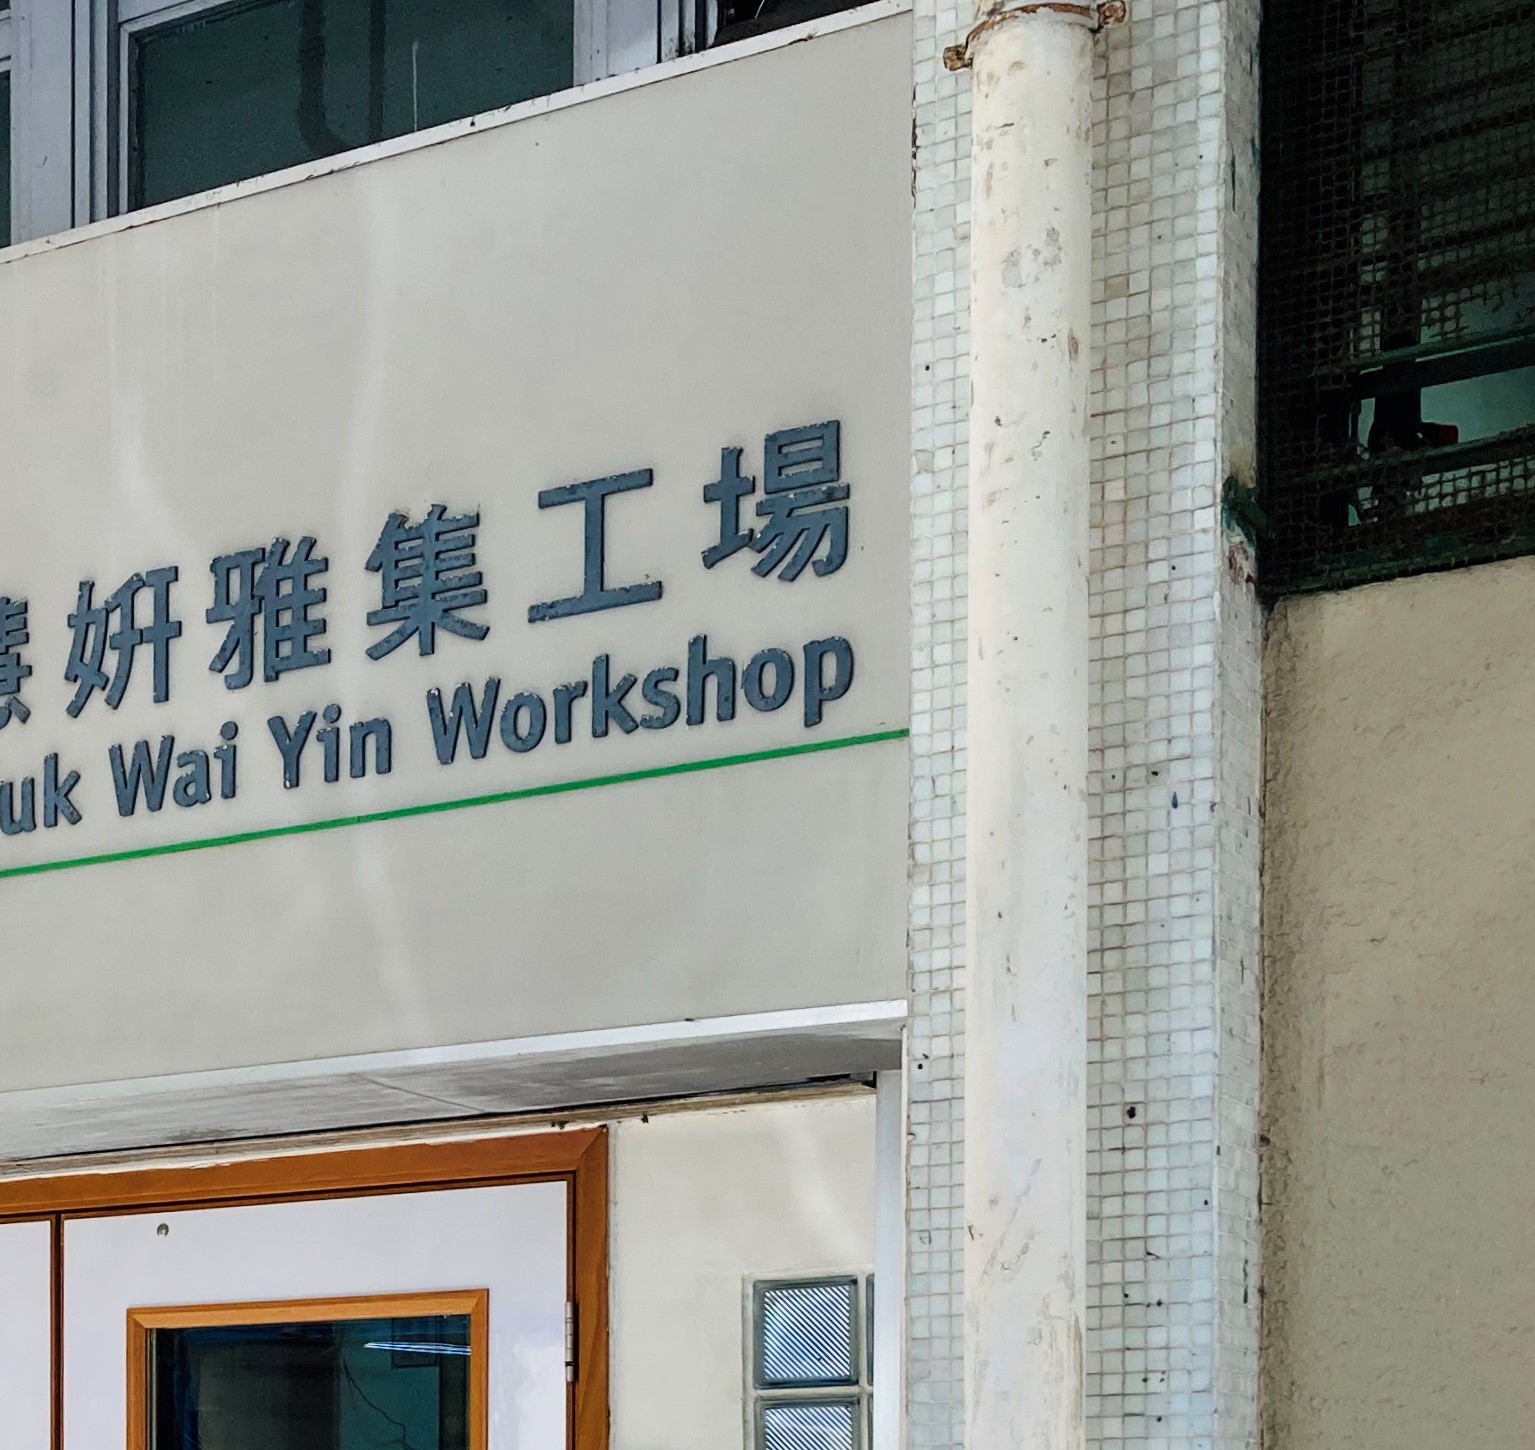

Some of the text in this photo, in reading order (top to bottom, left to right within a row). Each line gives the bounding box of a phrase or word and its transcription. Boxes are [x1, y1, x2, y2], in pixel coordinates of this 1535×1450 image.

[107, 720, 239, 818] Wai
[266, 703, 393, 790] Yin
[425, 635, 856, 766] Workshop
